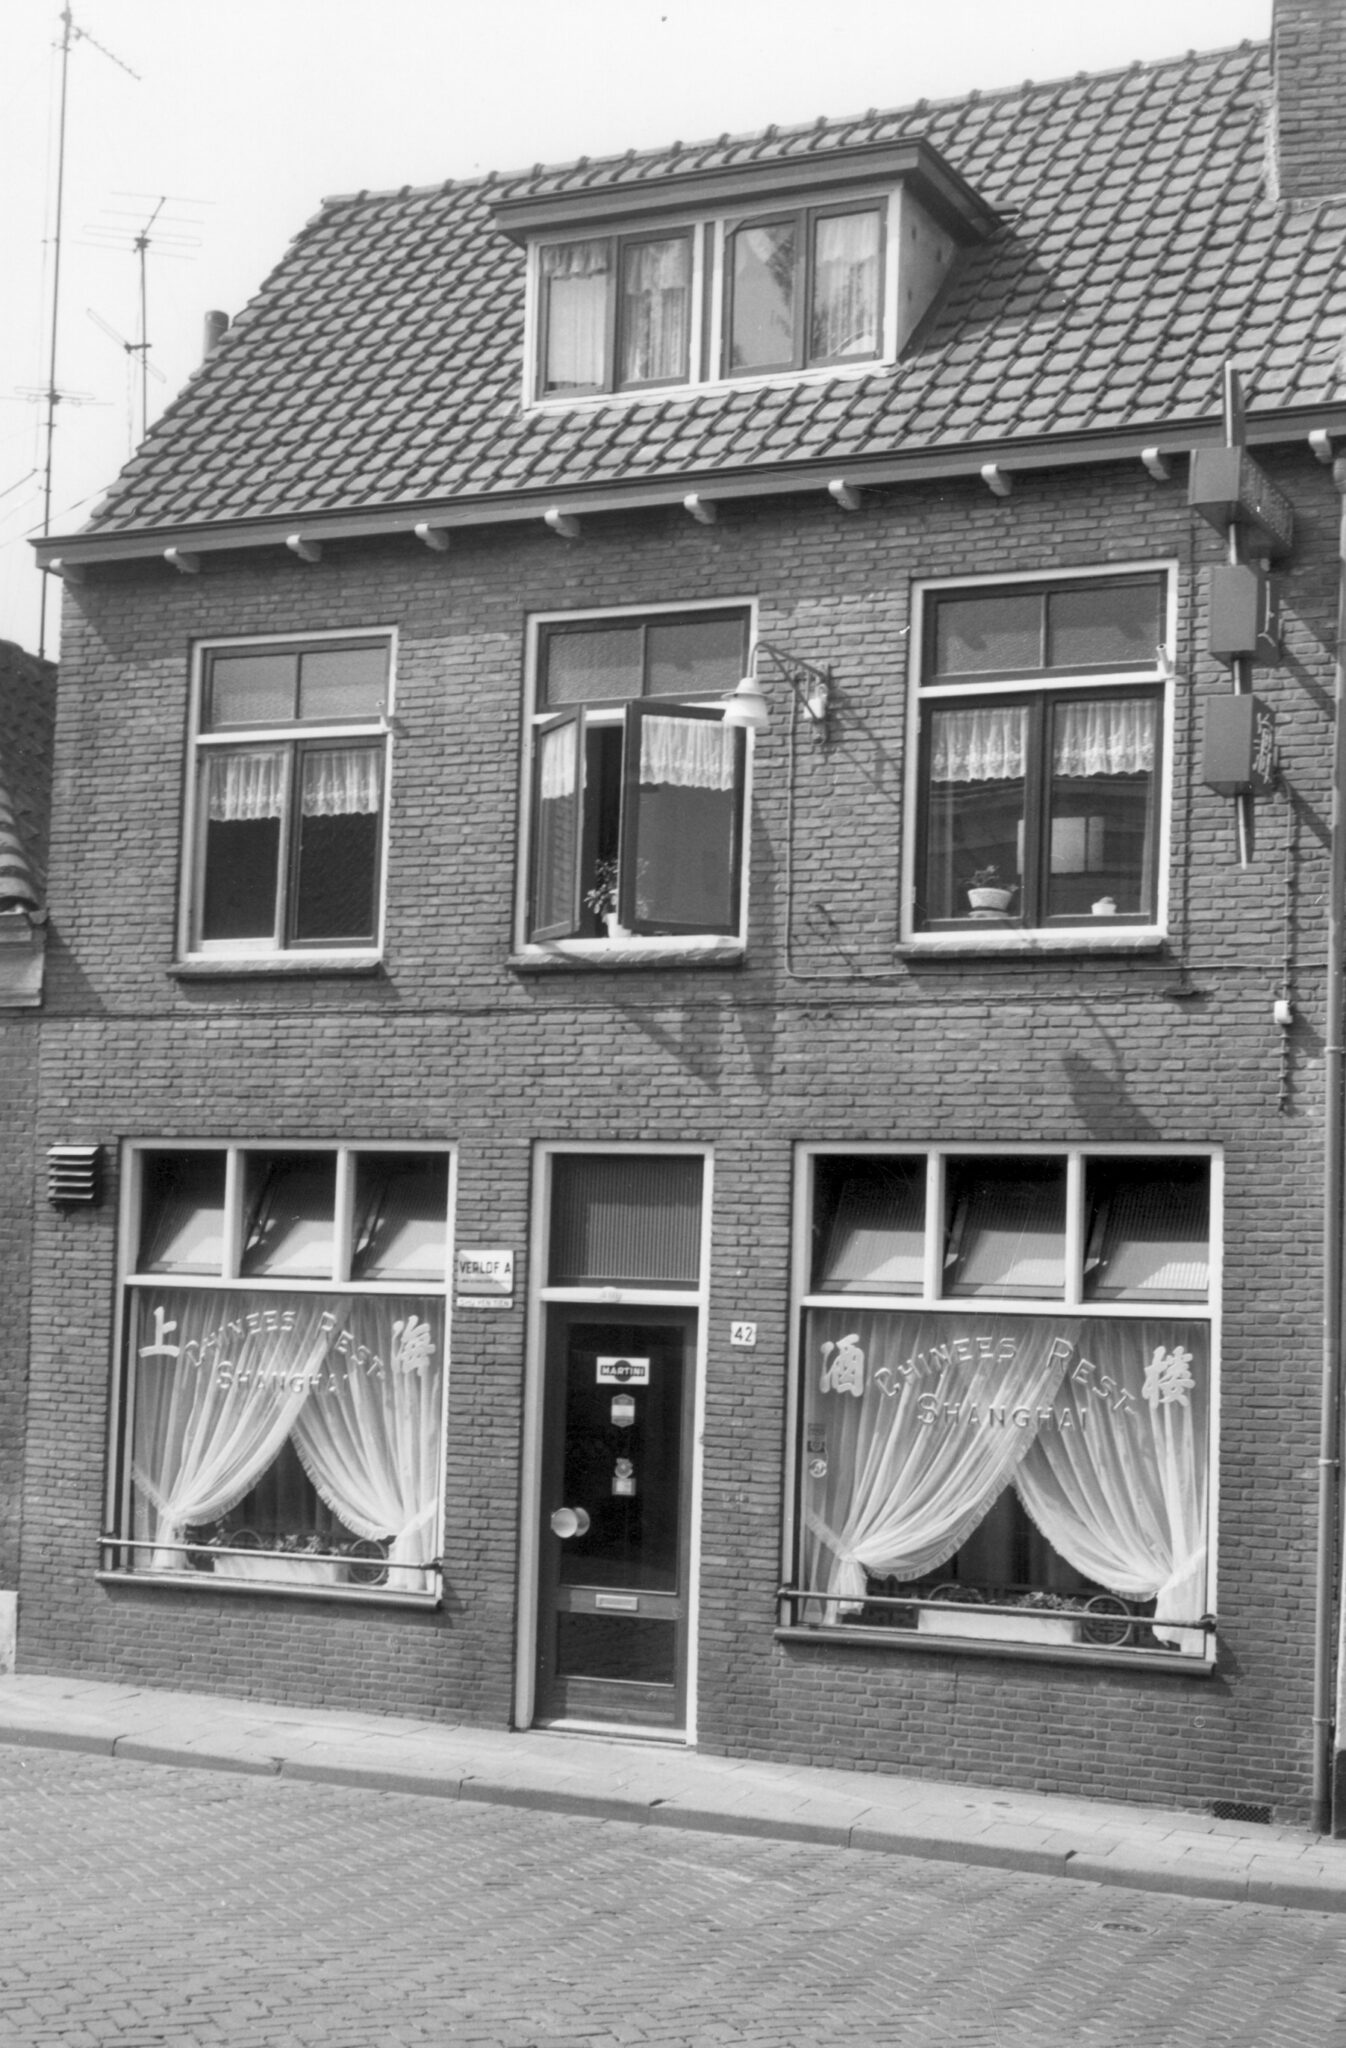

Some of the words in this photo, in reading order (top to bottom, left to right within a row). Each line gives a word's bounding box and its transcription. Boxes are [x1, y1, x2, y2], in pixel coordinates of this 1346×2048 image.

[459, 1260, 500, 1274] VERLOF
[504, 1261, 512, 1274] A
[139, 1305, 180, 1358] 上
[184, 1310, 297, 1367] CHINEES
[734, 1325, 753, 1342] 42
[216, 1360, 349, 1394] SHANGHAI
[601, 1366, 645, 1377] MARTINI
[819, 1333, 865, 1397] 酒
[874, 1336, 1017, 1397] CHINEES
[917, 1392, 1087, 1432] SHANGHAI
